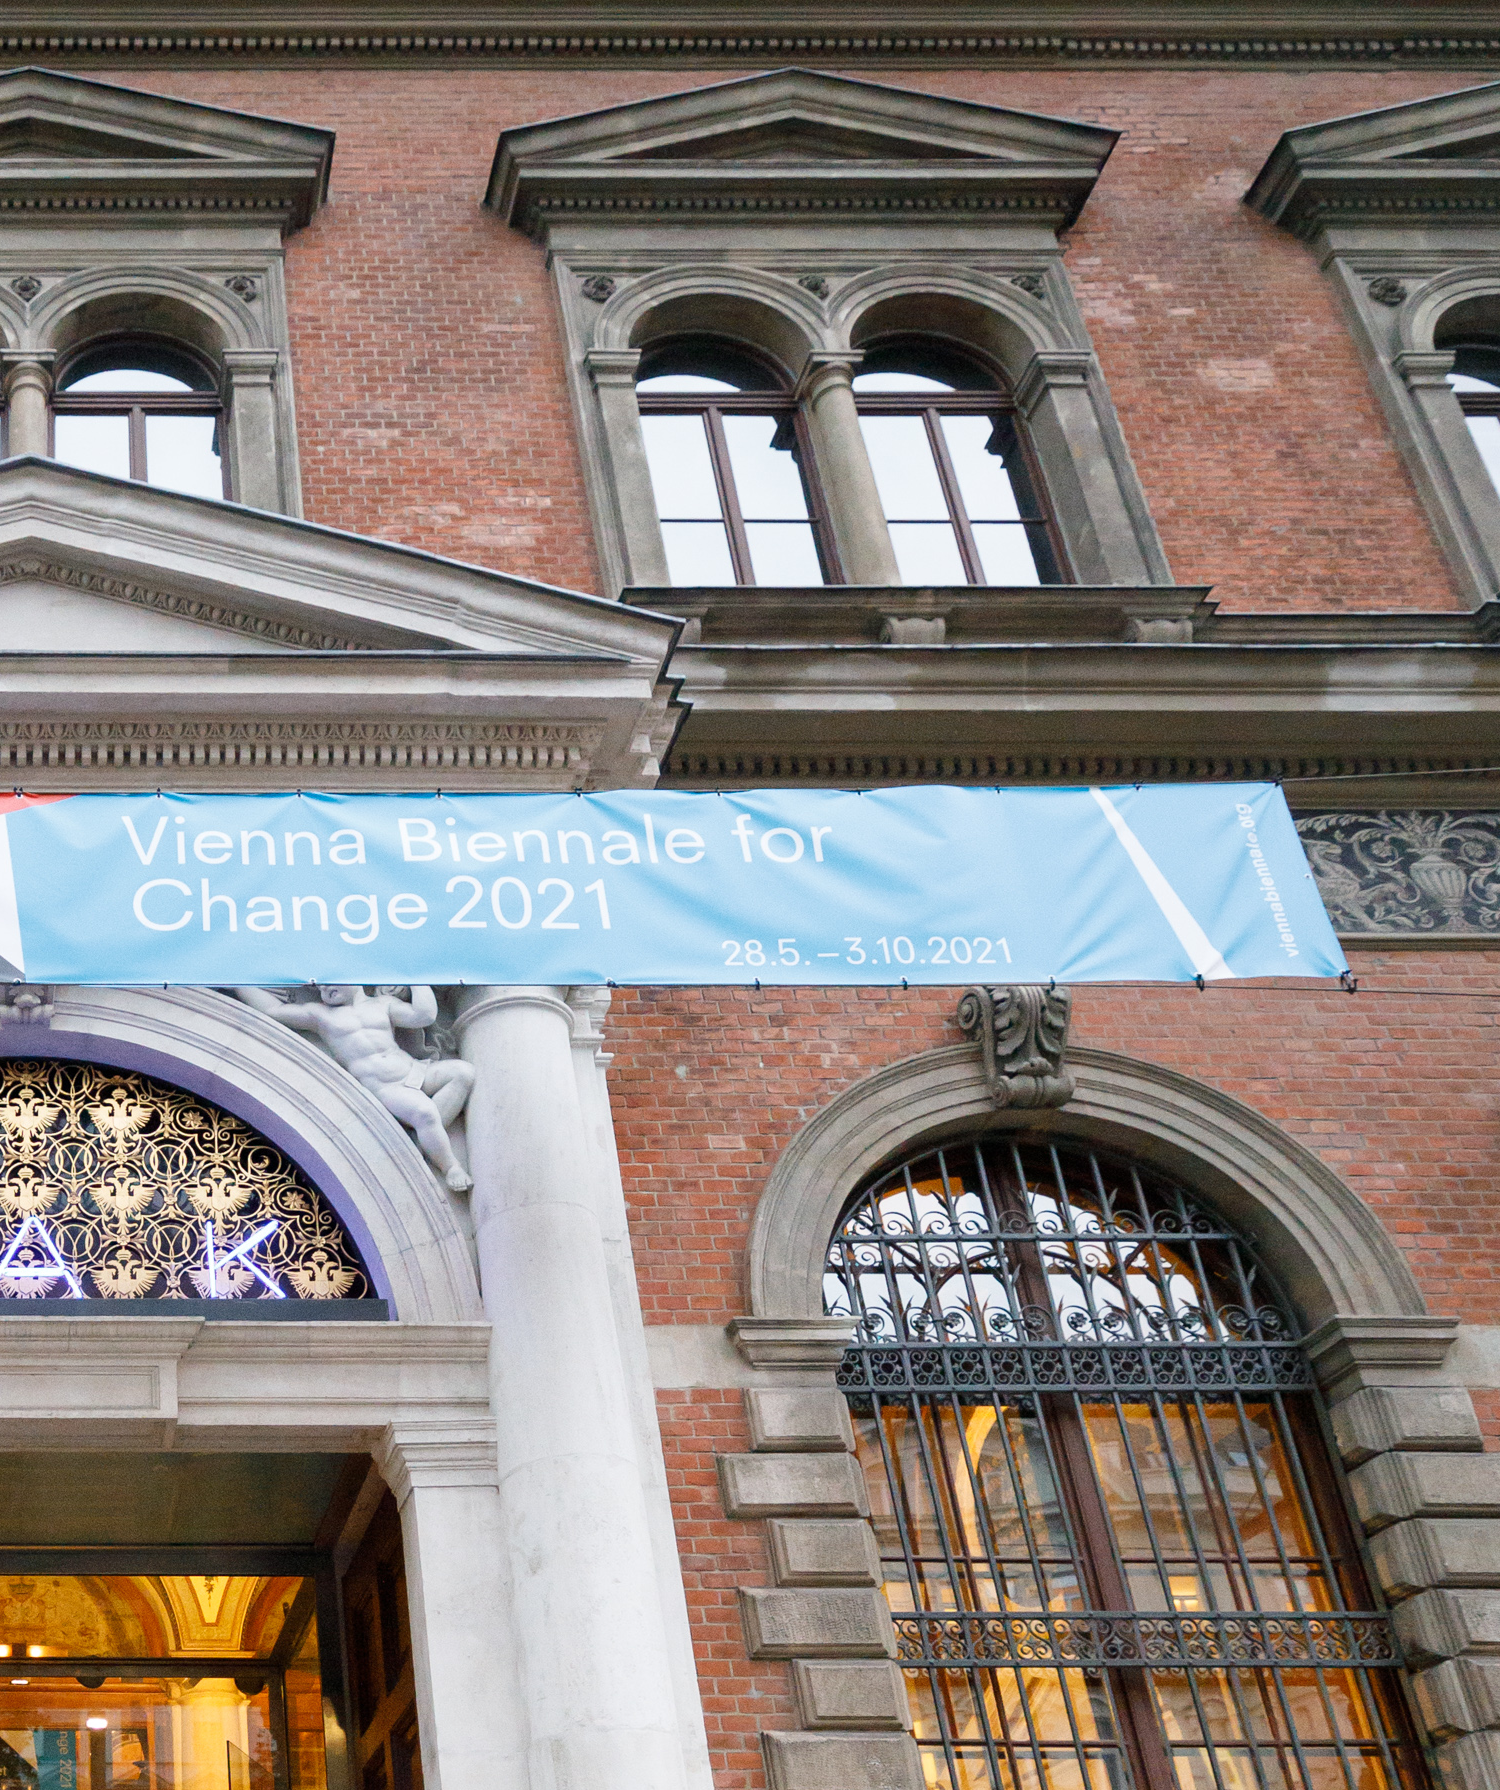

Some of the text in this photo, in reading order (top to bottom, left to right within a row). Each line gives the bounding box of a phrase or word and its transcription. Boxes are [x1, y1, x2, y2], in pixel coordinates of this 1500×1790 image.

[121, 812, 832, 866] Vienna Biennale for
[131, 875, 613, 947] Change 2021
[1238, 802, 1299, 959] viennabiennale.org
[59, 1759, 73, 1788] 2021
